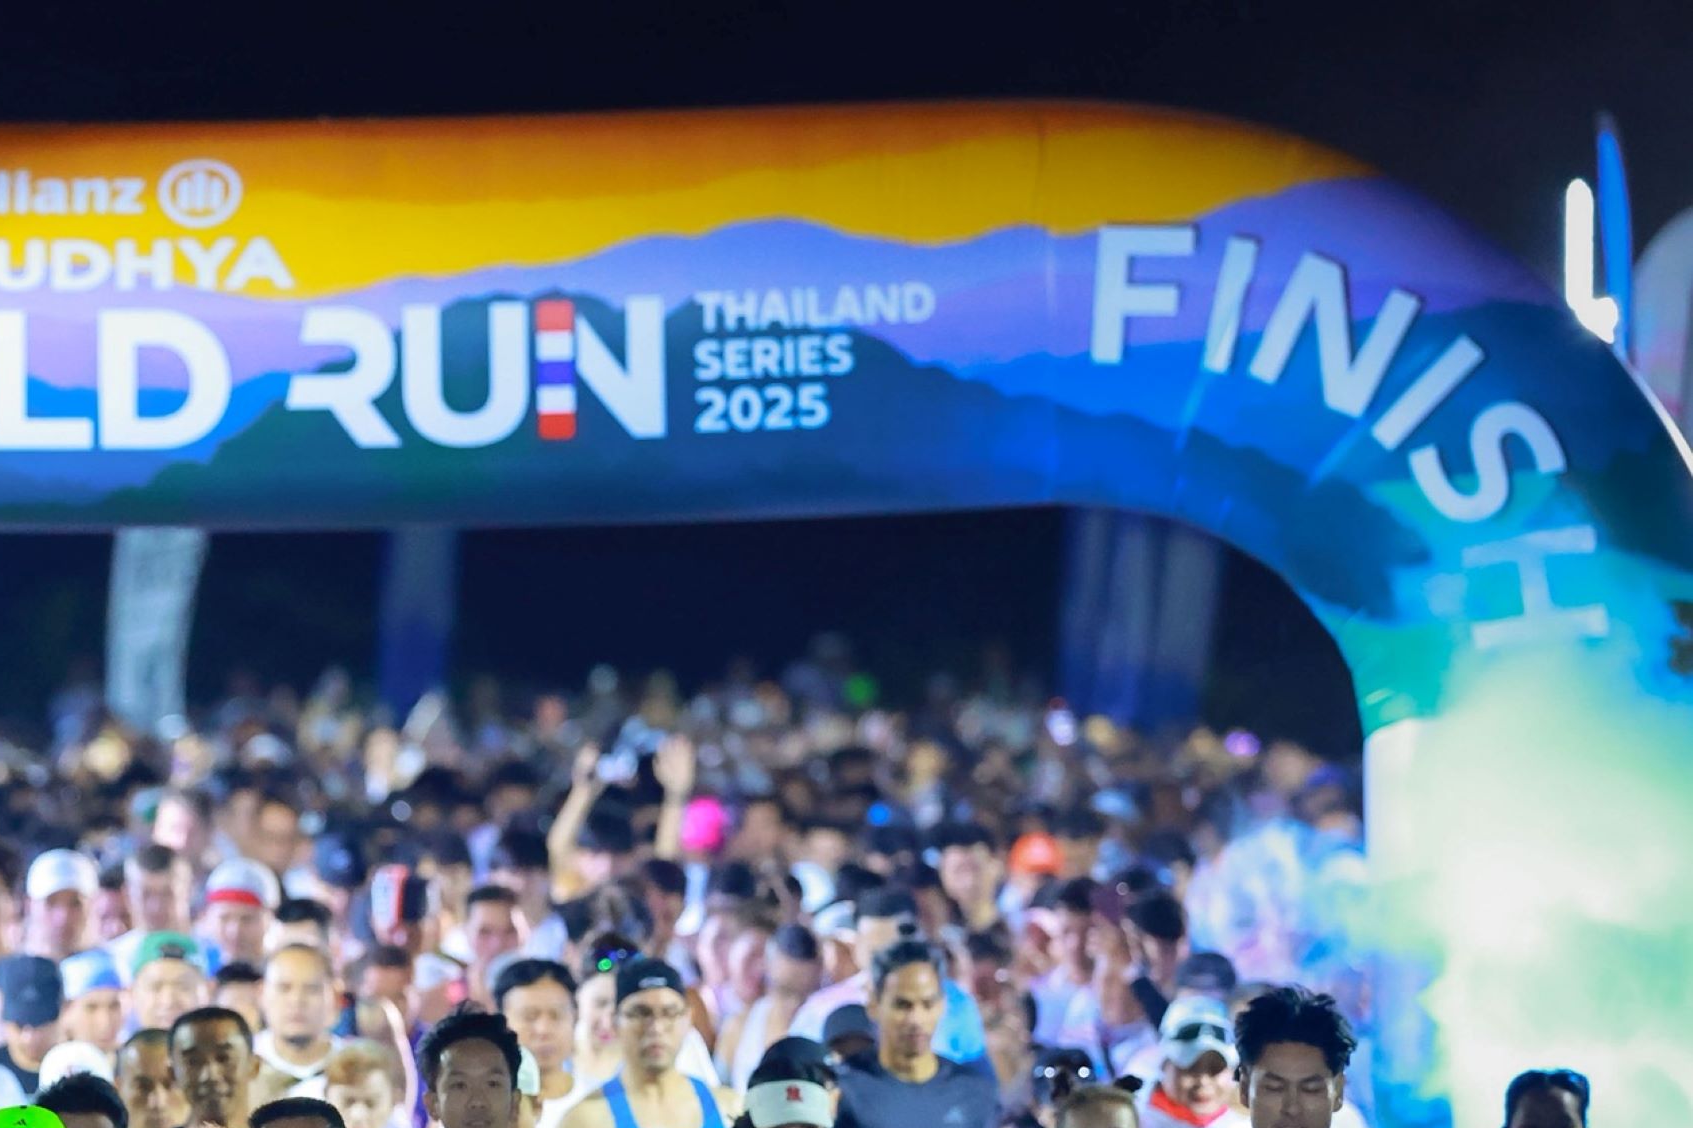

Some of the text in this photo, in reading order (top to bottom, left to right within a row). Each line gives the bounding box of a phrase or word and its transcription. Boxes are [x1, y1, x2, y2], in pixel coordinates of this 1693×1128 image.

[695, 281, 936, 332] THAILAND
[285, 295, 667, 449] RUN
[694, 333, 854, 381] SERIES
[694, 382, 831, 433] 2025
[1089, 225, 1608, 650] FINISH
